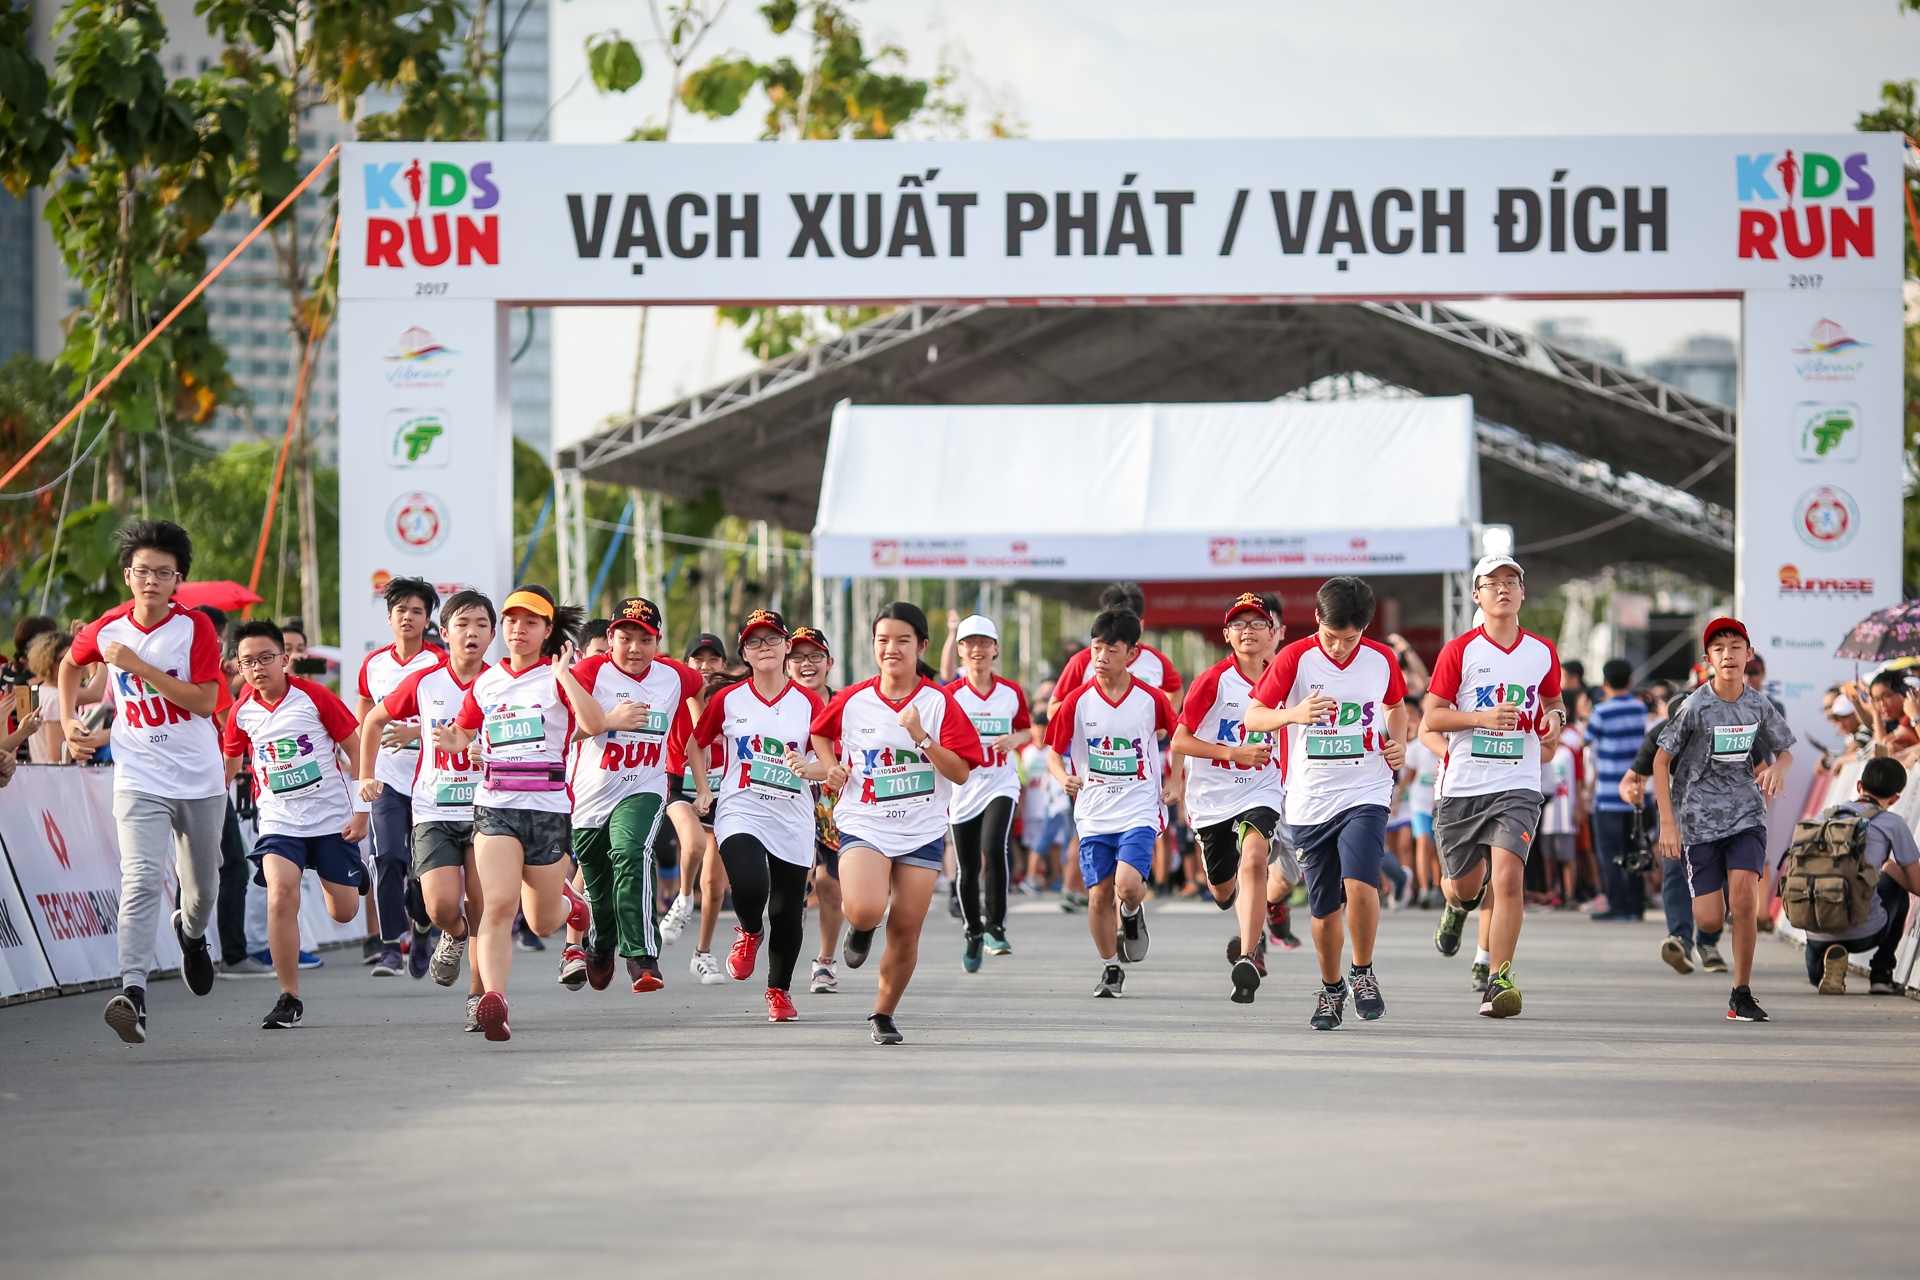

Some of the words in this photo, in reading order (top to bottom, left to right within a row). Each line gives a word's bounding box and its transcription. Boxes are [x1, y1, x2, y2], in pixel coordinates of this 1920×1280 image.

[363, 158, 500, 211] KIDS
[1735, 149, 1876, 204] KIDS
[566, 193, 760, 275] VẠCH
[788, 168, 979, 259] XUẤT
[1006, 171, 1194, 258] PHÁT
[1219, 190, 1250, 257] /
[1270, 188, 1466, 271] VẠCH
[1494, 169, 1669, 253] ĐÍCH
[364, 213, 500, 269] RUN
[1737, 205, 1876, 261] RUN
[414, 282, 449, 296] 2017
[1788, 274, 1825, 290] 2017
[1475, 682, 1537, 709] KIDS
[498, 721, 532, 740] 7040
[975, 720, 1002, 733] 7079
[150, 733, 169, 744] 2017
[1318, 739, 1352, 754] 7125
[1483, 739, 1514, 754] 7165
[1725, 735, 1752, 750] 7136
[599, 740, 663, 772] RUN
[1097, 758, 1127, 771] 7045
[277, 768, 309, 787] 7051
[763, 766, 793, 786] 7122
[886, 775, 921, 794] 7017
[1107, 786, 1123, 794] 2017
[886, 810, 907, 819] 2017
